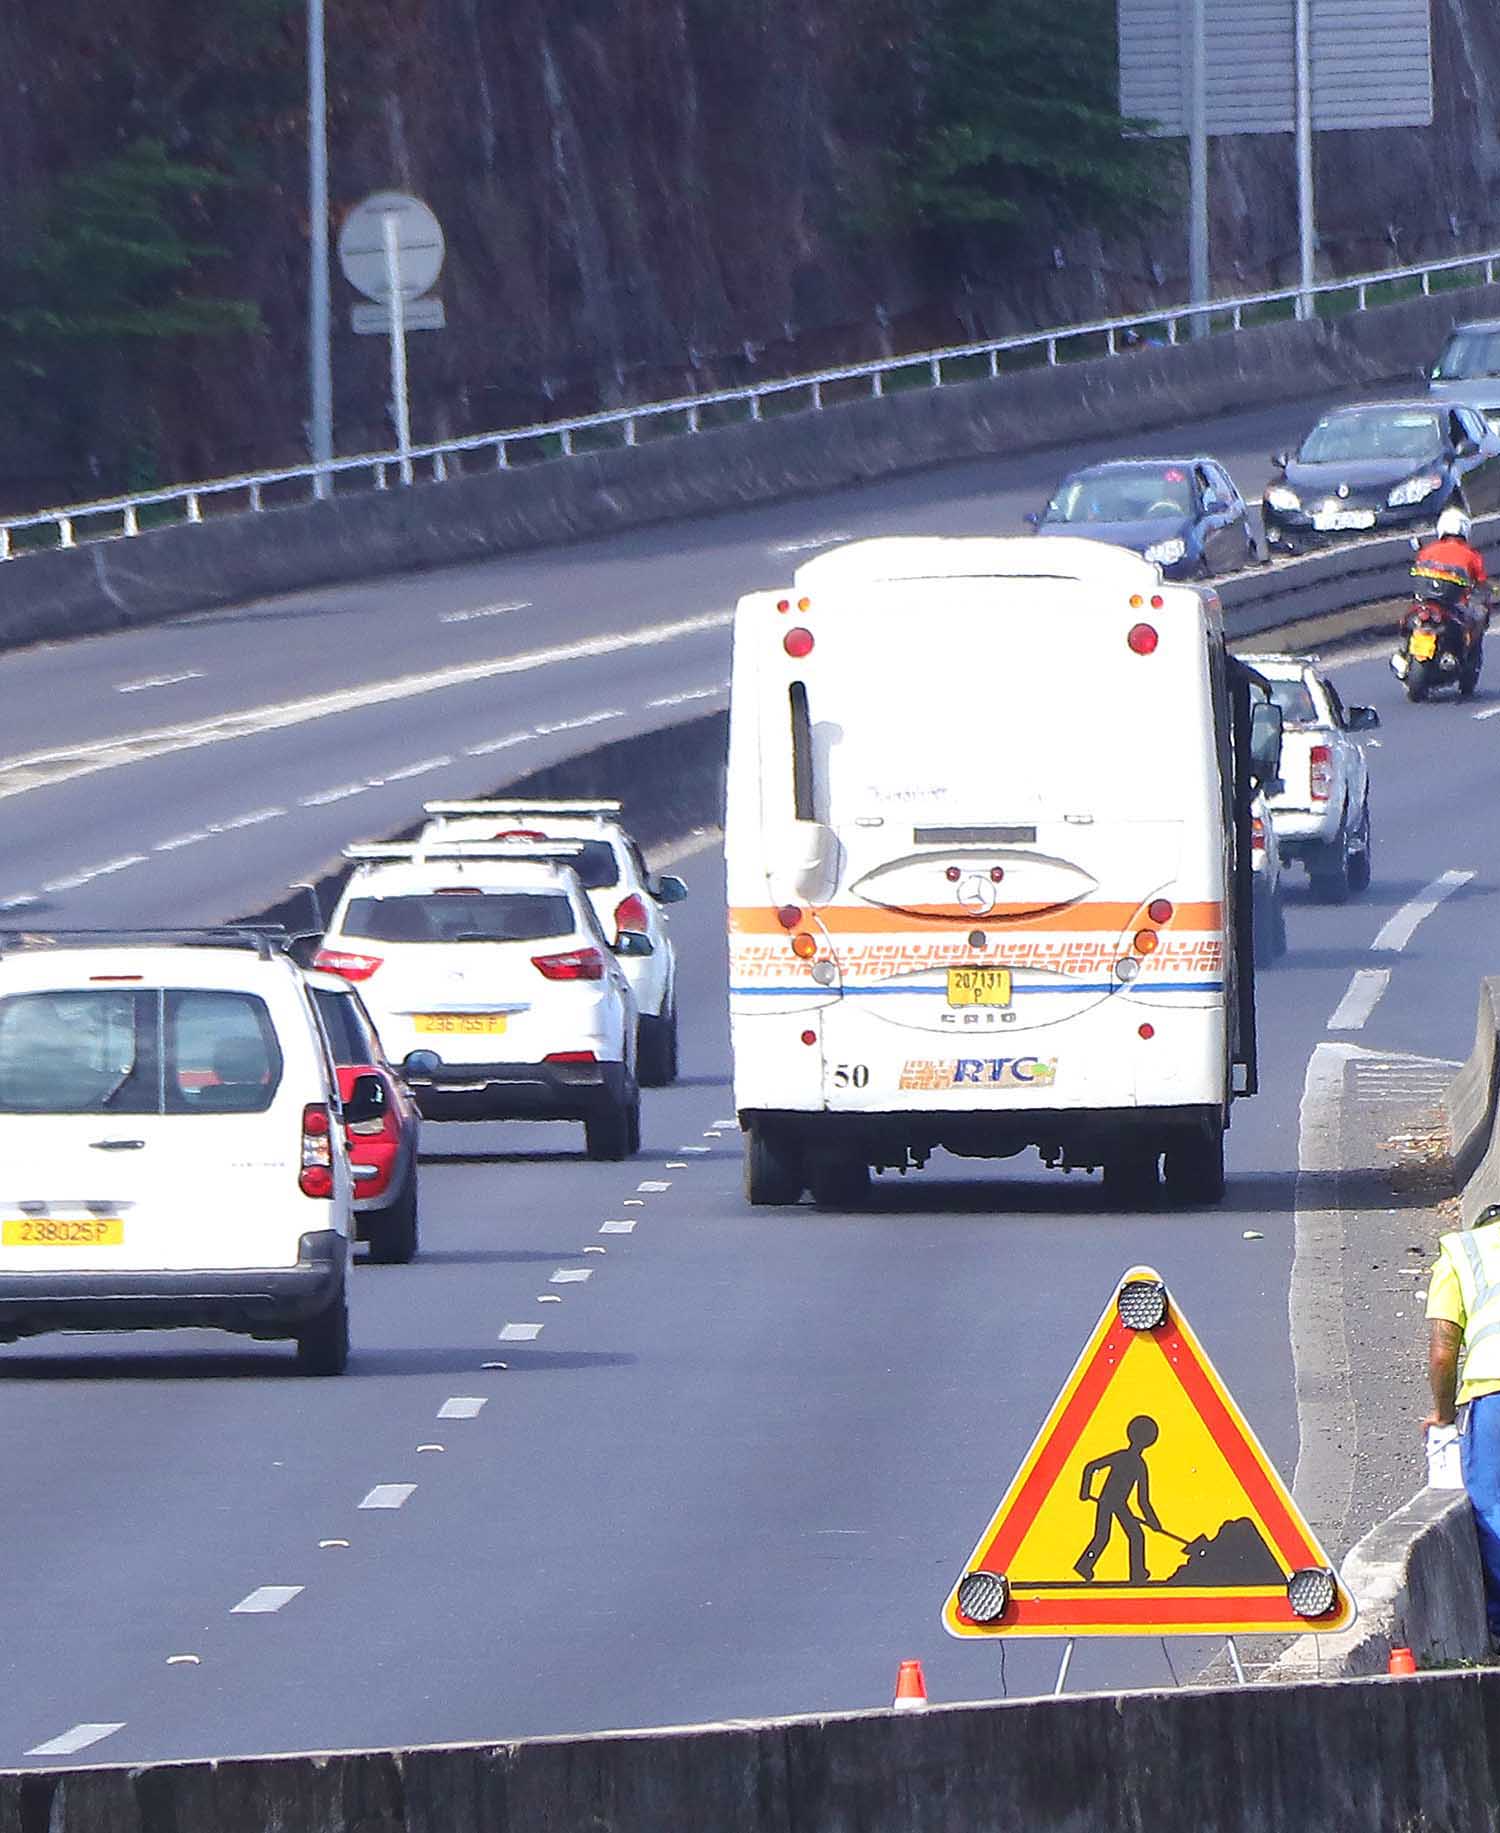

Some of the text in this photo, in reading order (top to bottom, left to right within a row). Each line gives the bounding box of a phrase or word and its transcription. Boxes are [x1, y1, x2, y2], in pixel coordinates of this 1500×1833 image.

[955, 972, 1003, 989] 207131
[974, 988, 983, 1003] P
[834, 1064, 869, 1088] 50
[953, 1056, 1039, 1082] RTC
